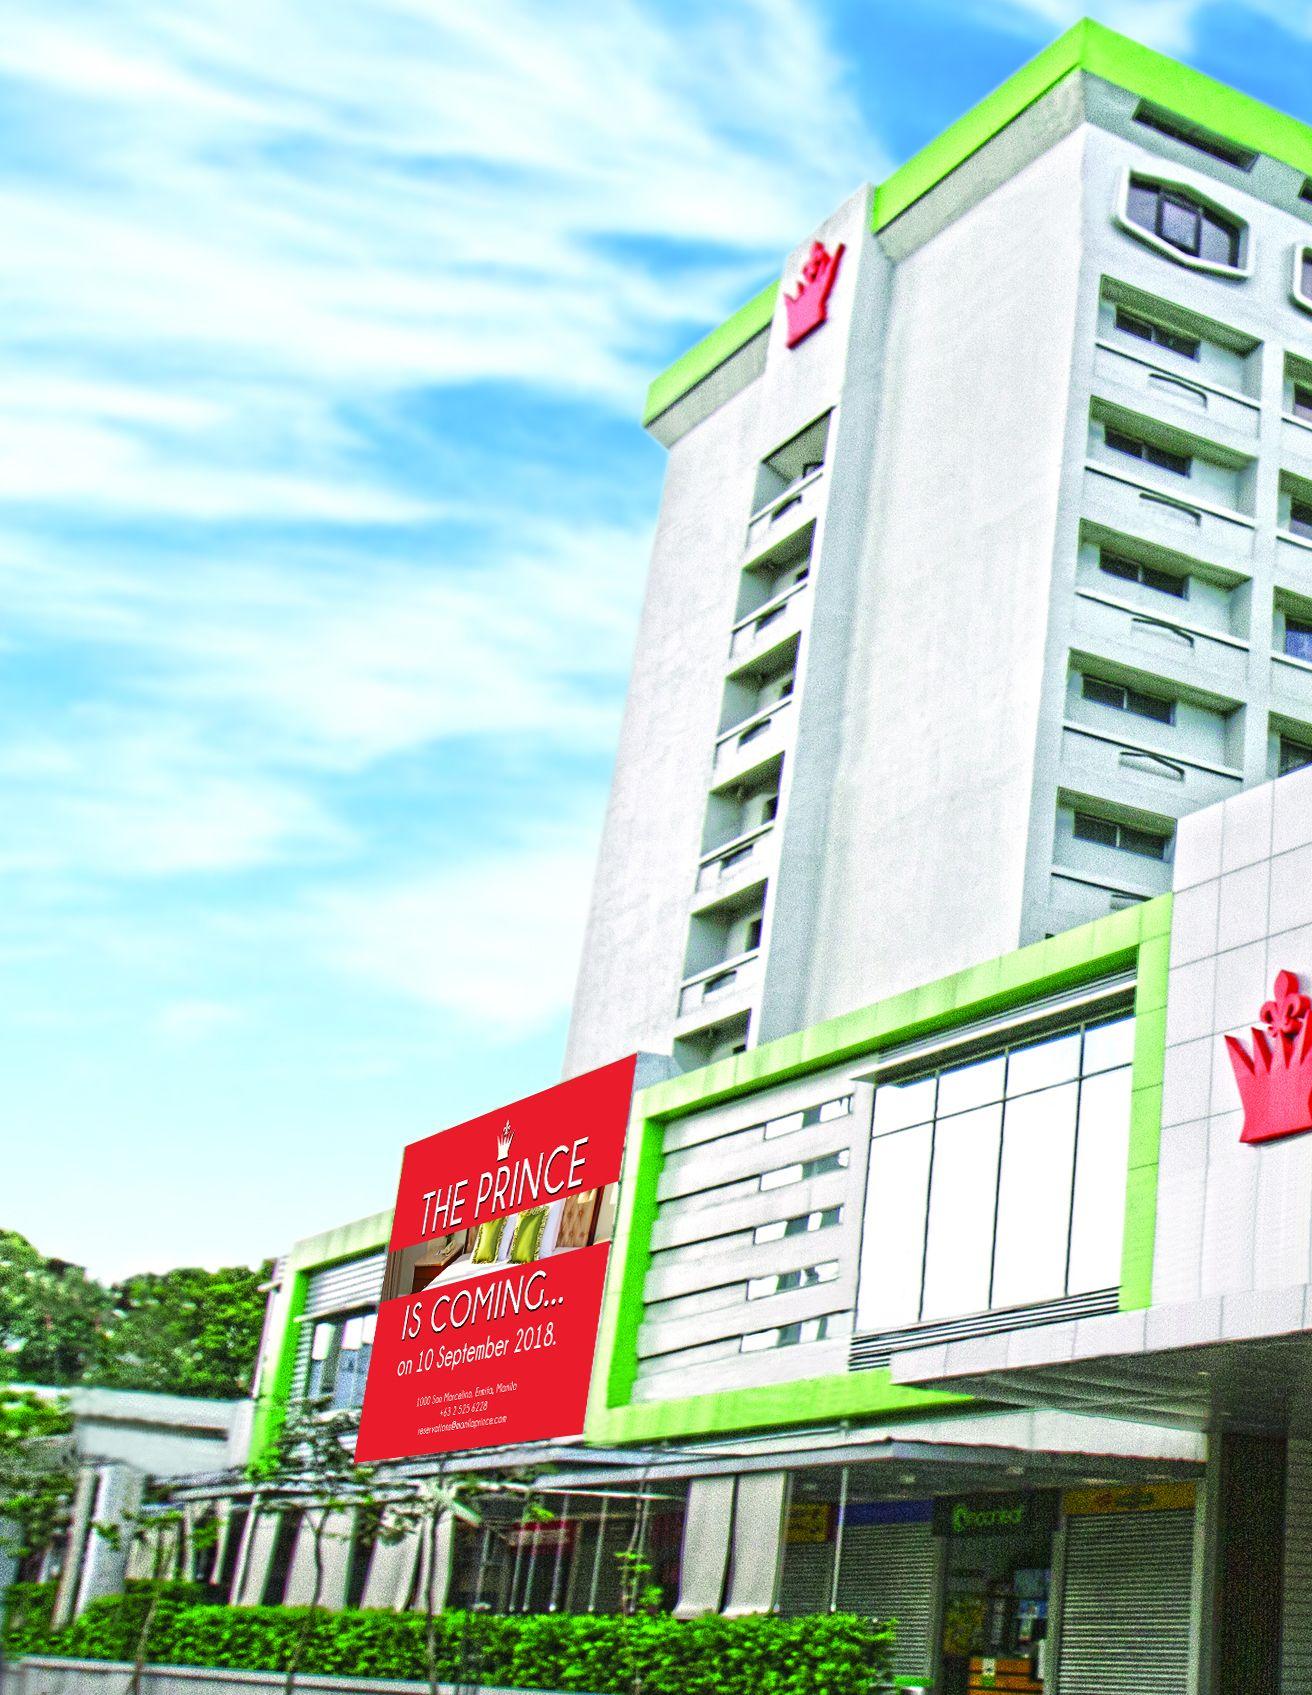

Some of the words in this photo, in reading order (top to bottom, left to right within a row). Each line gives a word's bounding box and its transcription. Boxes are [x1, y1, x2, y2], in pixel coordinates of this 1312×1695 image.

[421, 1179, 468, 1236] THE
[474, 1136, 589, 1219] PRINCE
[401, 1301, 422, 1340] IS
[431, 1270, 564, 1333] COMING...
[397, 1359, 412, 1376] on
[416, 1349, 433, 1373] 10
[437, 1336, 509, 1371] September
[514, 1322, 557, 1354] 2018.
[440, 1406, 451, 1417] +63
[459, 1402, 470, 1415] 525
